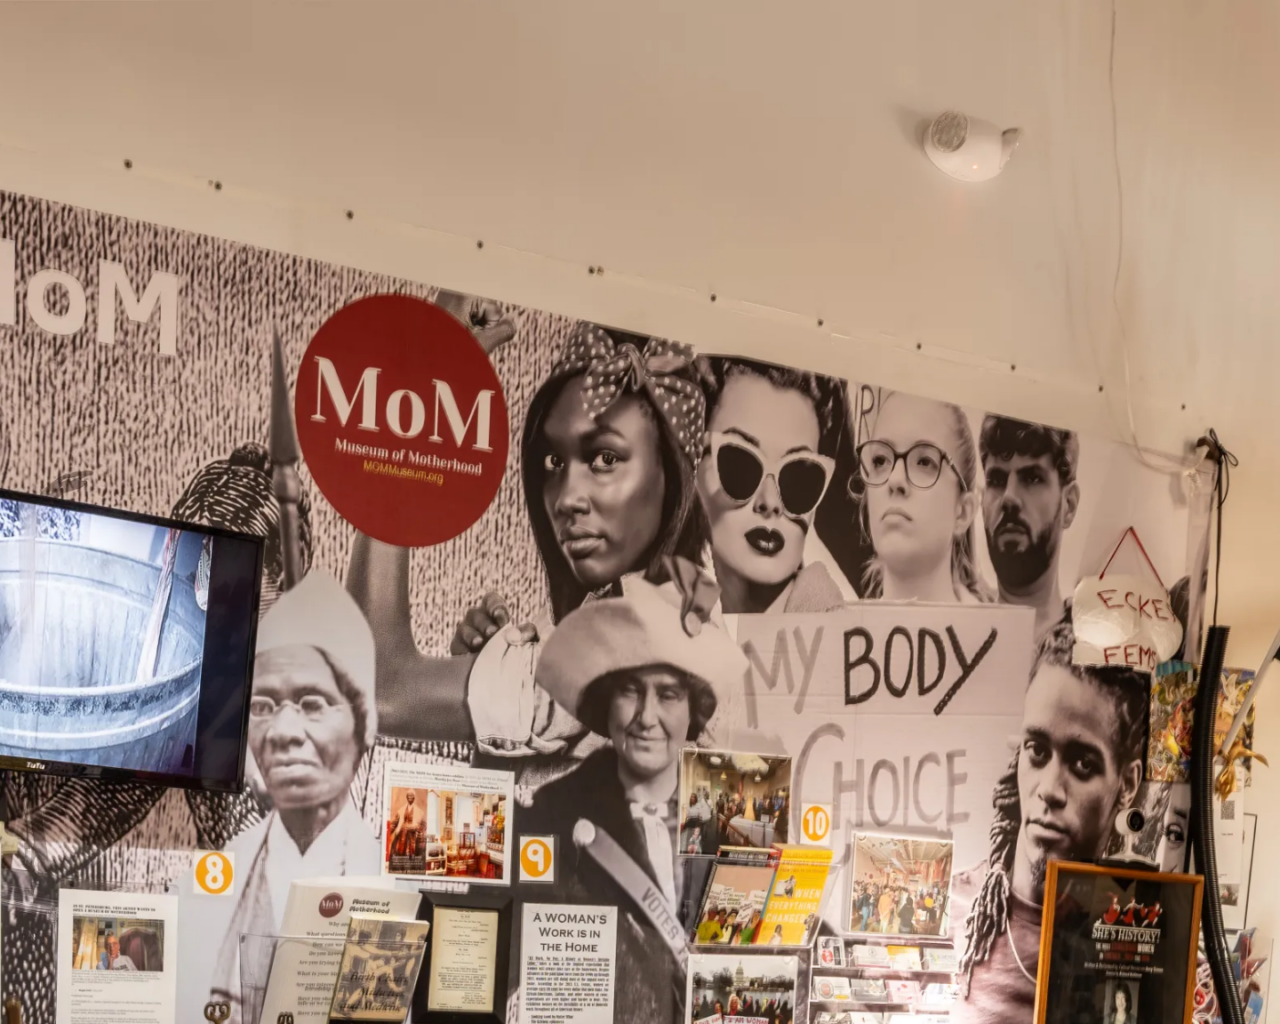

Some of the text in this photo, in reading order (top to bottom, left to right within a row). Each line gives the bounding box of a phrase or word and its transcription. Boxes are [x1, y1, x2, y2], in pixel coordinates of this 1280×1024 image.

[310, 355, 496, 453] MoM
[334, 437, 483, 475] Museum of Motherhood
[363, 459, 444, 486] MOMMuseum.org
[740, 624, 998, 729] MY BODY
[791, 723, 970, 858] CHOICE
[806, 808, 827, 833] 10
[527, 843, 545, 872] 9
[205, 854, 225, 890] 8
[794, 888, 822, 899] WHEN
[319, 898, 344, 912] MoM
[349, 905, 390, 915] Motherhood
[352, 898, 380, 907] Museum
[769, 901, 818, 912] EVERYTHING
[533, 913, 608, 924] A WOMAN'S
[641, 886, 680, 940] VOTES
[765, 913, 805, 923] CHANGED
[539, 927, 601, 938] WORK IS IN
[1092, 925, 1161, 943] SHE'S HISTORY!
[540, 942, 598, 952] THE HOME
[350, 971, 375, 981] Birth
